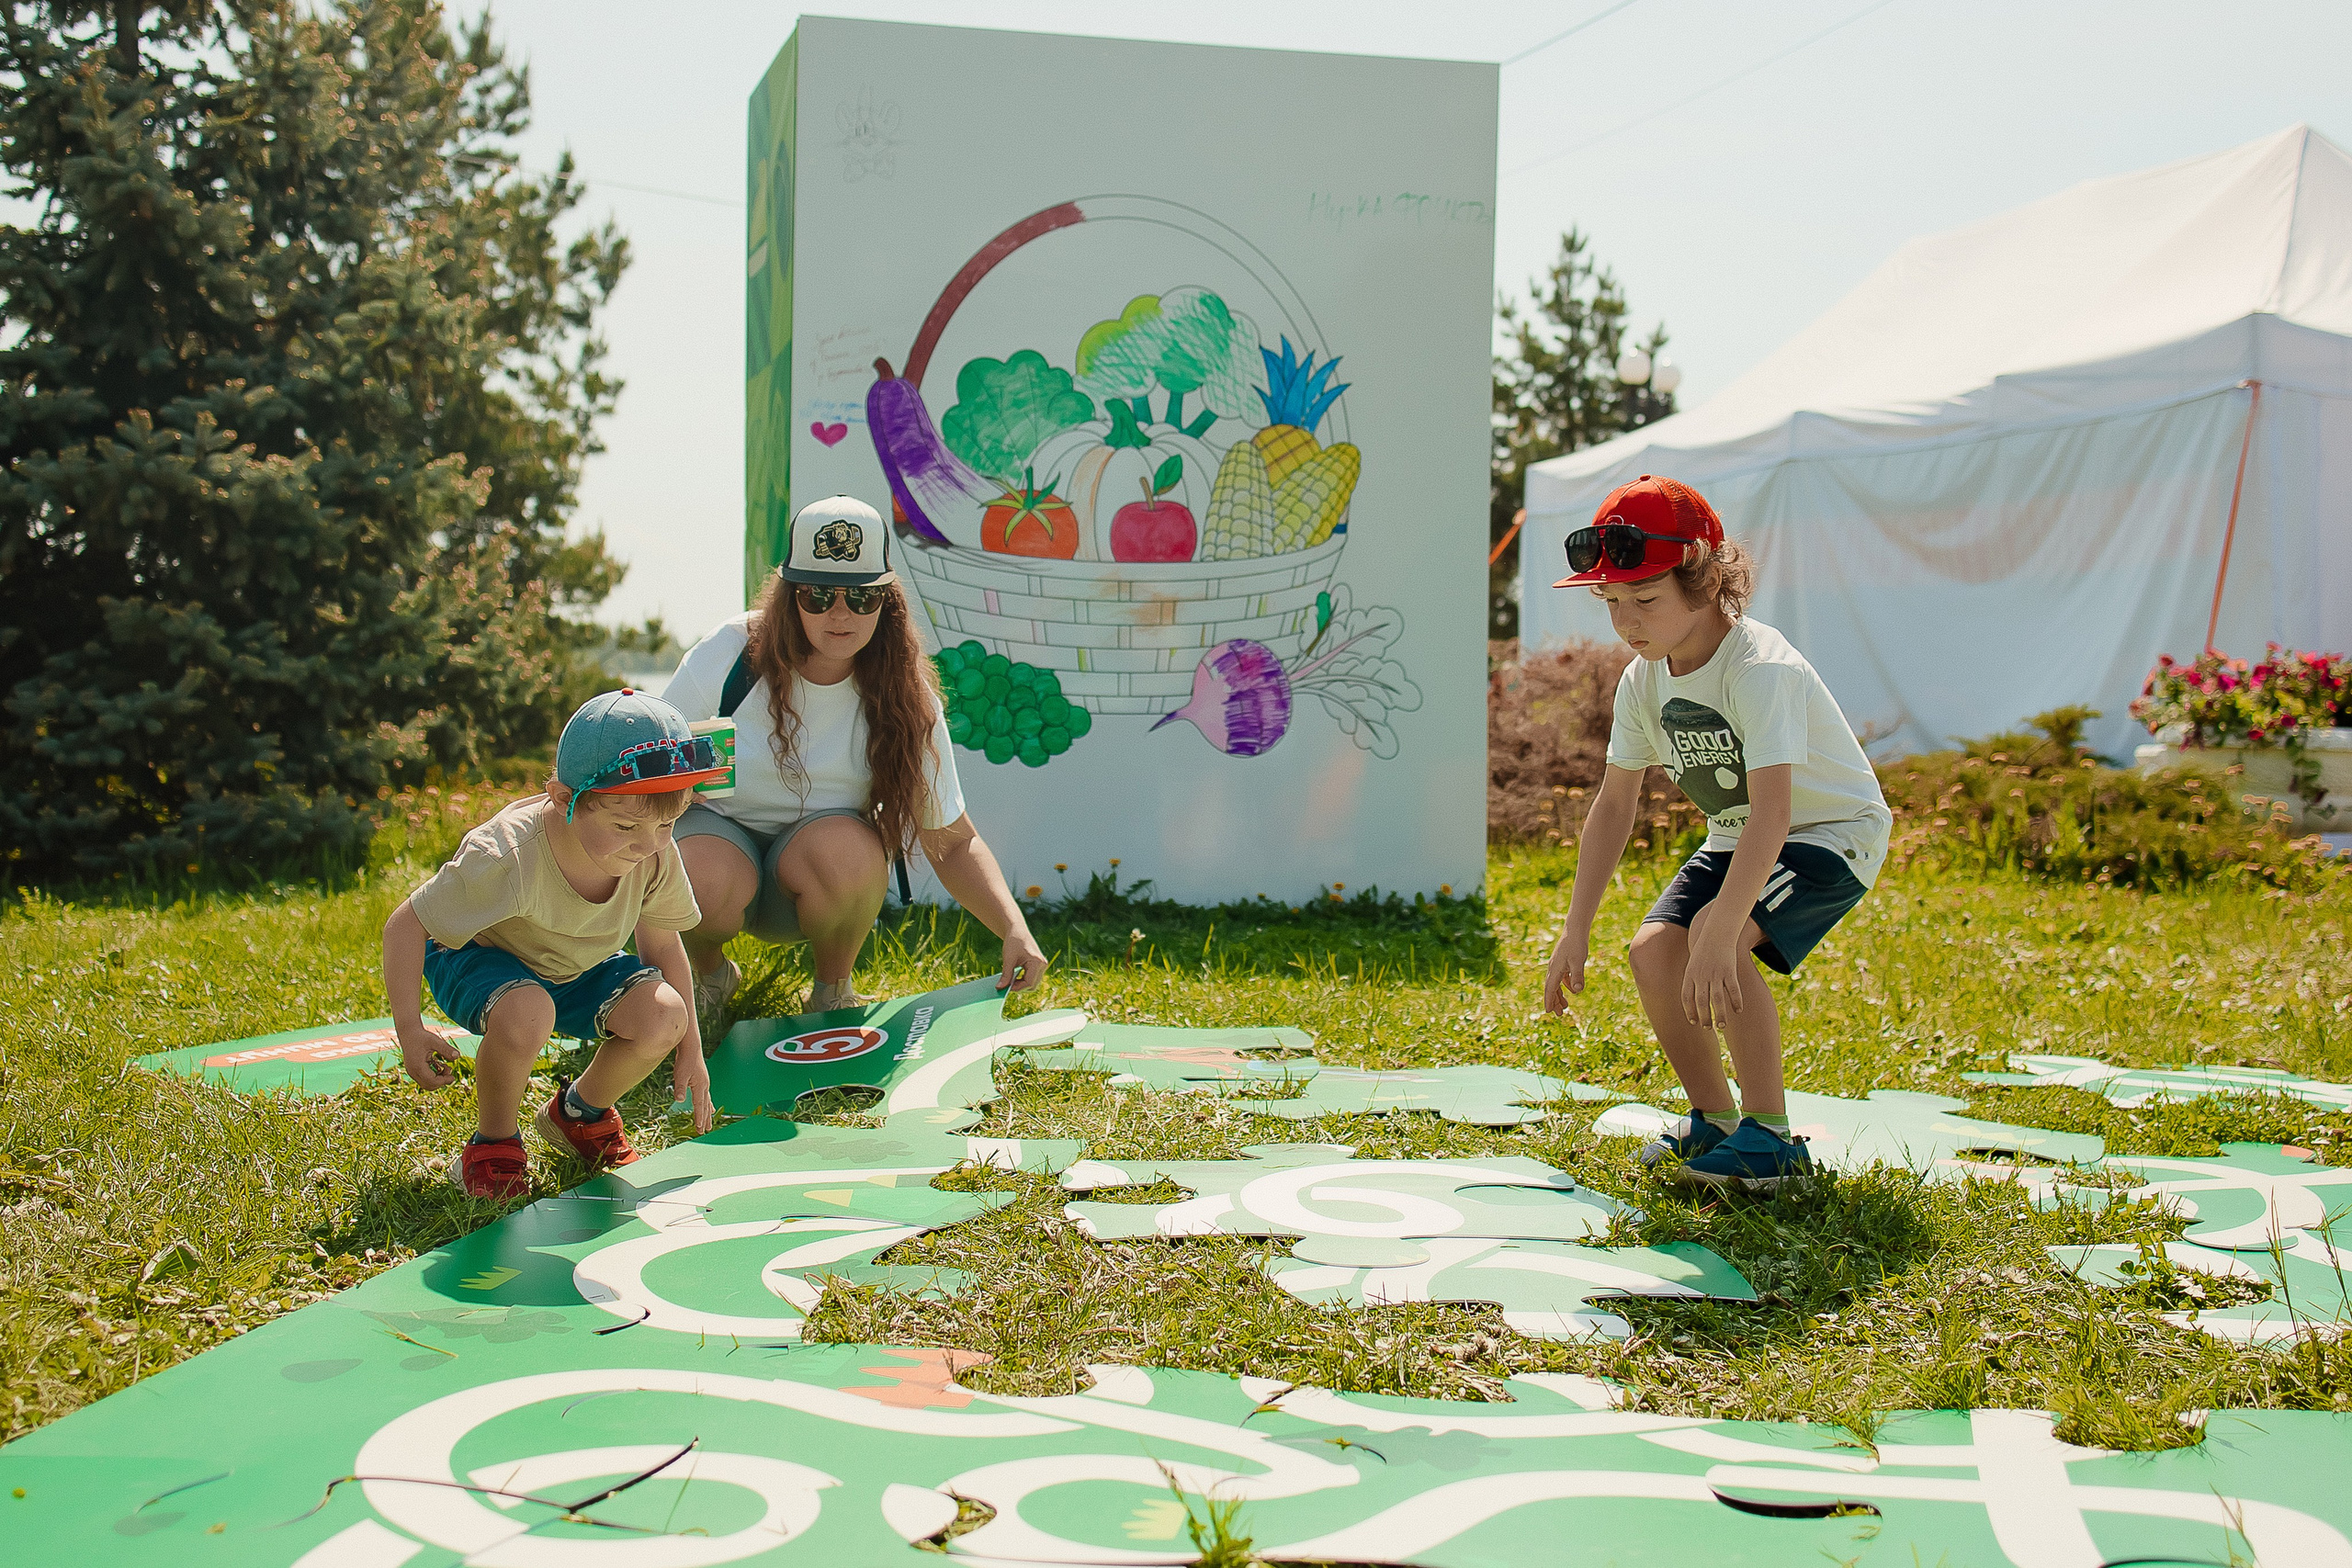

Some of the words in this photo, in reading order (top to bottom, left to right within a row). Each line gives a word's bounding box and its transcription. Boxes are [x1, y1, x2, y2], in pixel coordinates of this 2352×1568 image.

[1674, 728, 1735, 752] GOOD
[1680, 750, 1741, 768] ENERGY
[892, 1005, 934, 1062] Доставка
